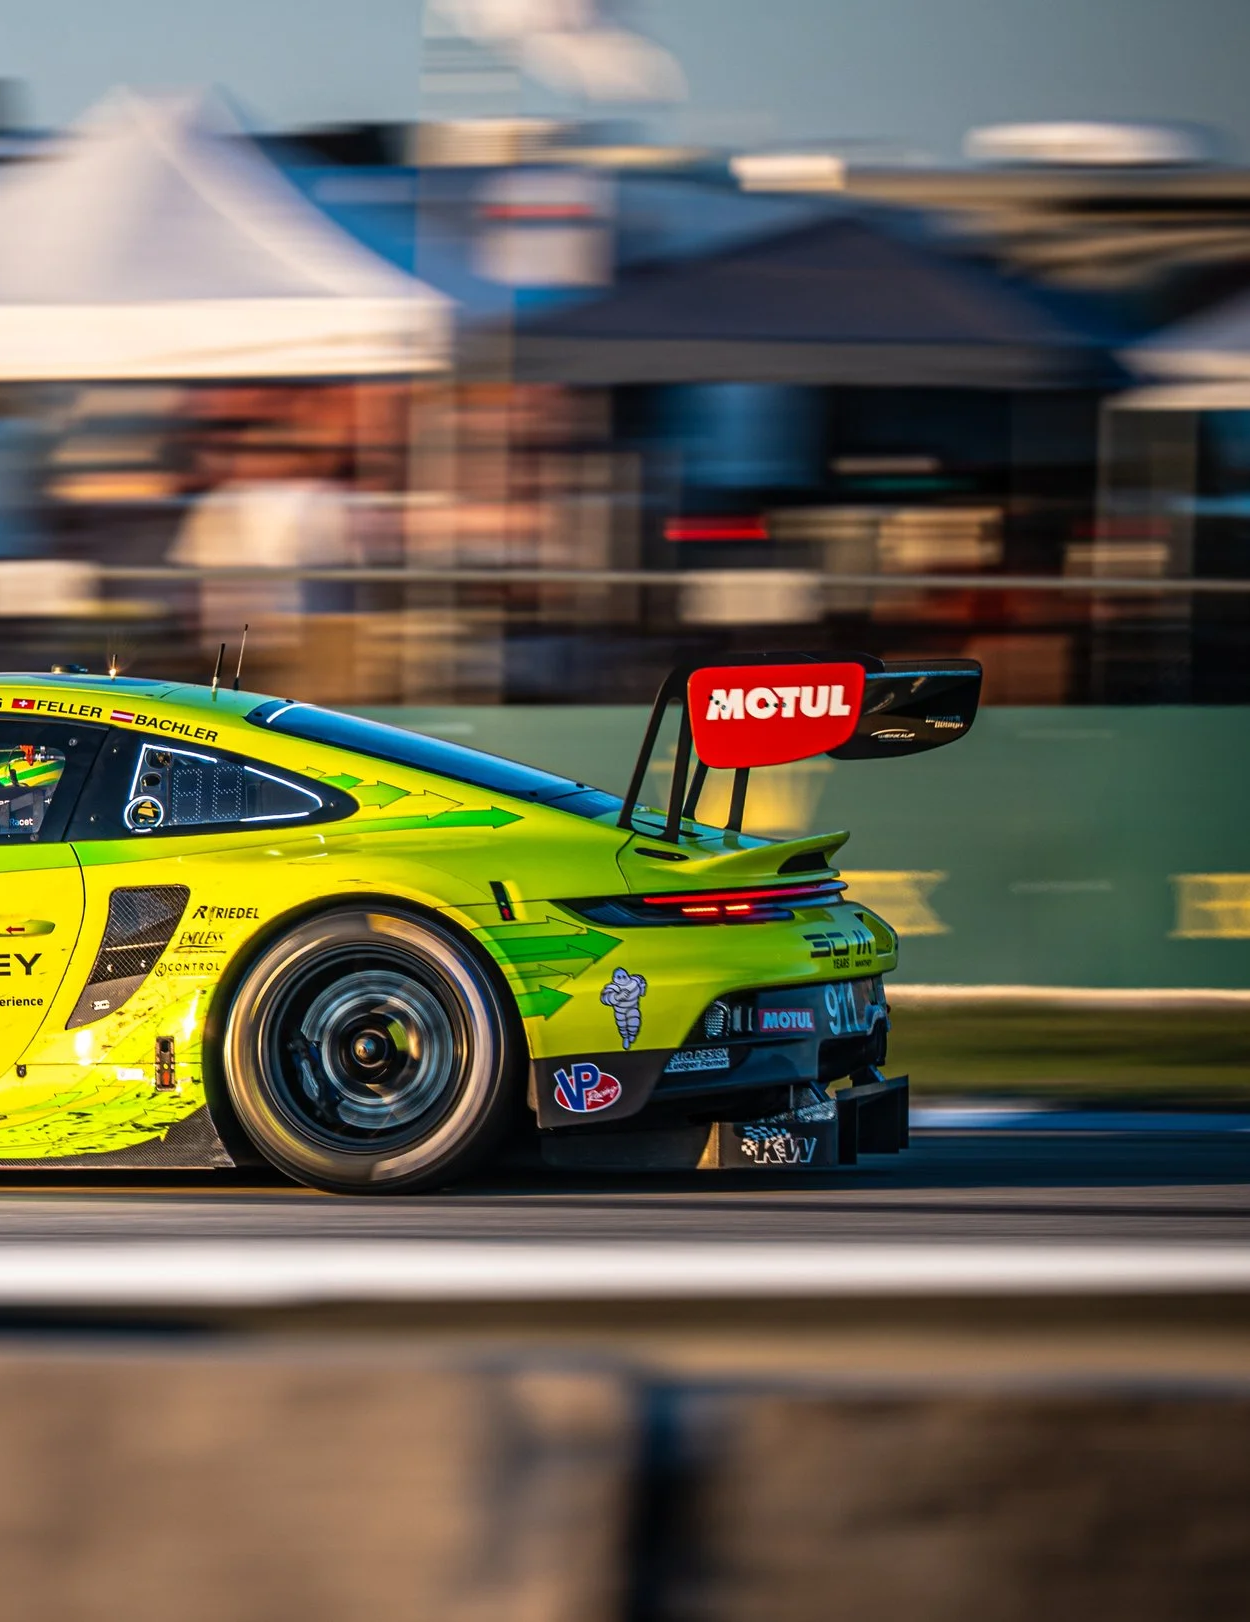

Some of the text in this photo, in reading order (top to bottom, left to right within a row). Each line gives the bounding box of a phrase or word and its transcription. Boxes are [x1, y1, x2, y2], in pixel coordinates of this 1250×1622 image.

[705, 684, 851, 721] MOTUL
[36, 699, 103, 719] FELLER
[134, 714, 219, 743] BACHLER
[215, 907, 260, 919] RIEDEL
[179, 931, 226, 945] ENDLESS
[167, 962, 221, 972] CONTROL
[762, 1011, 814, 1030] MOTUL
[824, 981, 861, 1036] 911
[553, 1062, 601, 1113] VP
